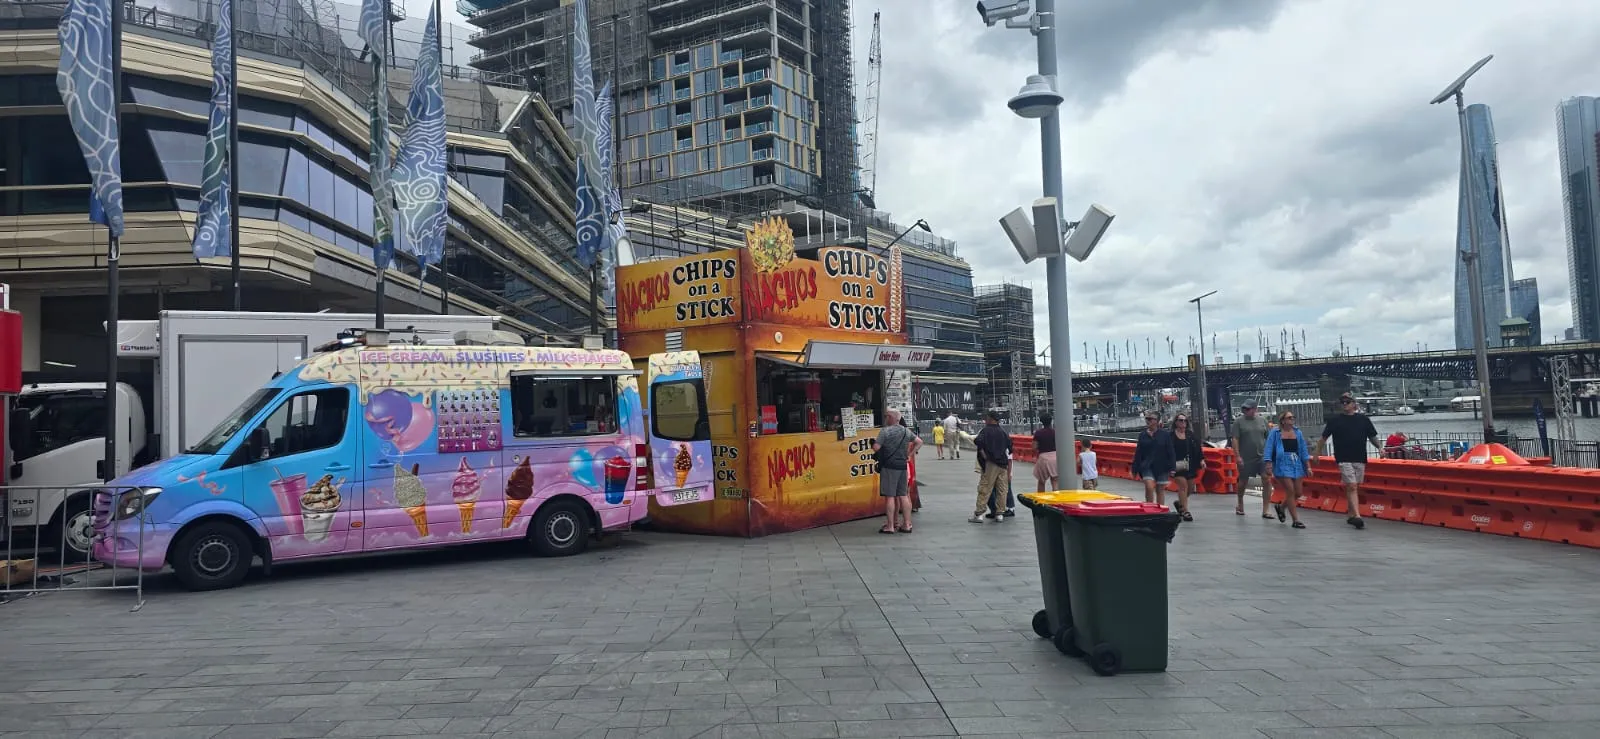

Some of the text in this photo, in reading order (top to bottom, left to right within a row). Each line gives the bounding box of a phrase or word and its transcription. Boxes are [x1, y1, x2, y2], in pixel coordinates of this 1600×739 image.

[672, 259, 737, 285] CHIPS
[824, 249, 888, 285] CHIPS
[621, 271, 670, 322] NACHOS
[688, 283, 721, 297] on a
[744, 266, 817, 320] NACHOS
[842, 281, 874, 299] on a
[676, 297, 736, 321] STICK
[828, 301, 889, 331] STICK
[456, 351, 525, 363] SLUSHIES
[537, 352, 621, 364] MILKSHAKES
[713, 445, 738, 459] IPS
[848, 438, 876, 454] CHI
[767, 441, 816, 488] NACHOS
[850, 463, 881, 476] STIC
[1471, 514, 1491, 523] Coates
